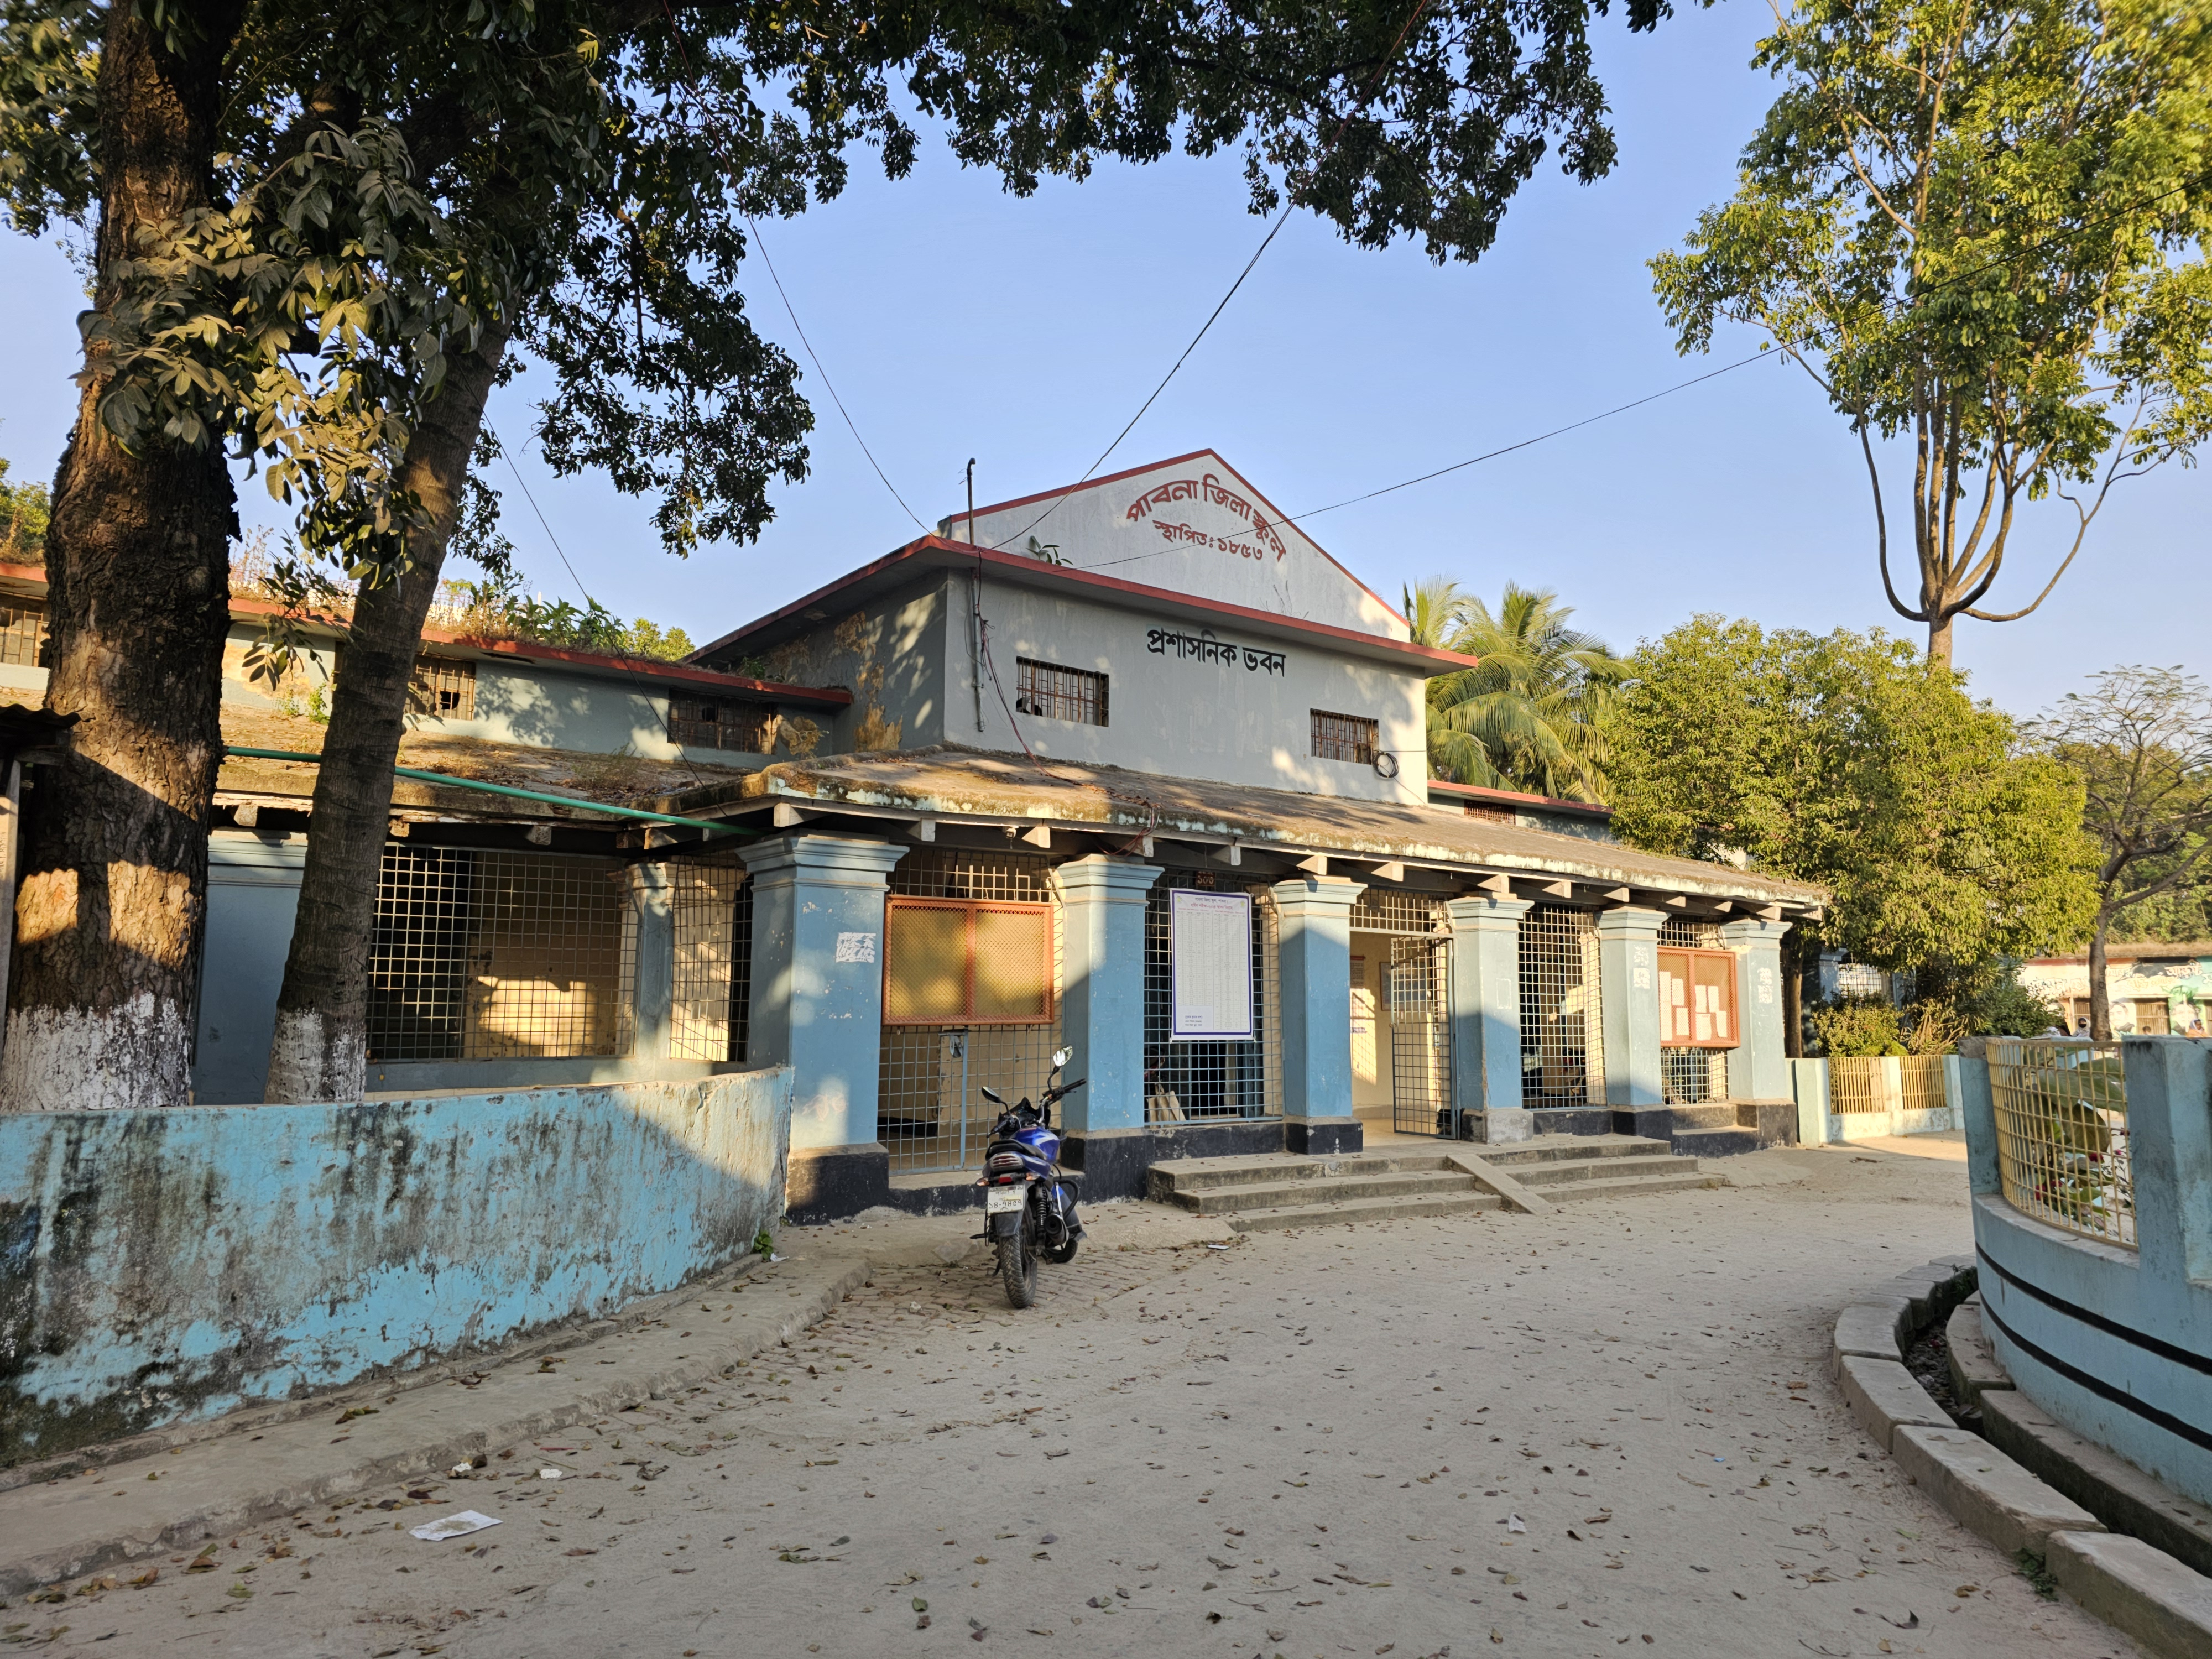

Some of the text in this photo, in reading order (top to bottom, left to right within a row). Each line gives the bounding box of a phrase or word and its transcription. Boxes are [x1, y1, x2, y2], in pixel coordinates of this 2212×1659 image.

[1126, 473, 1287, 562] পাবনা জিলা স্কুল
[1217, 538, 1263, 561] ১৮৫৩
[1147, 627, 1286, 678] প্রশাসনিক ভবন
